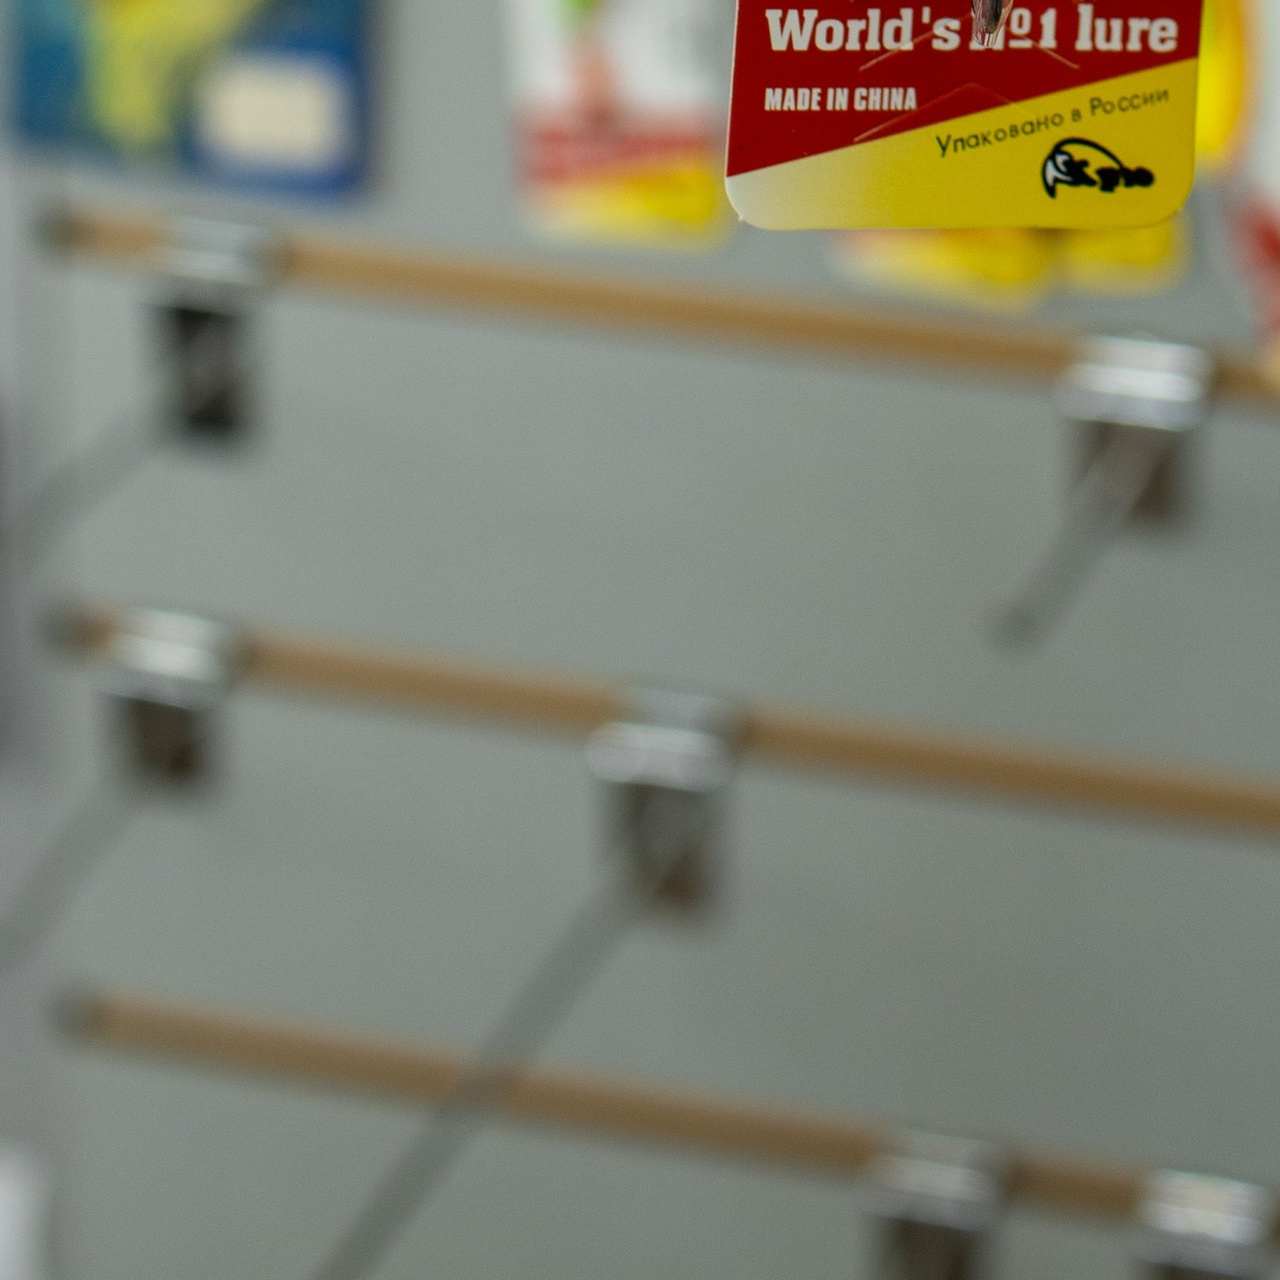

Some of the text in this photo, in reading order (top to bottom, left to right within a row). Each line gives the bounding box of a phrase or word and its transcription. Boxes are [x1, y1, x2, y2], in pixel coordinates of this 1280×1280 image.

[765, 6, 961, 51] World's
[1075, 3, 1179, 52] lure
[764, 87, 918, 111] MADE IN CHINA
[936, 89, 1170, 157] Упаковано в России
